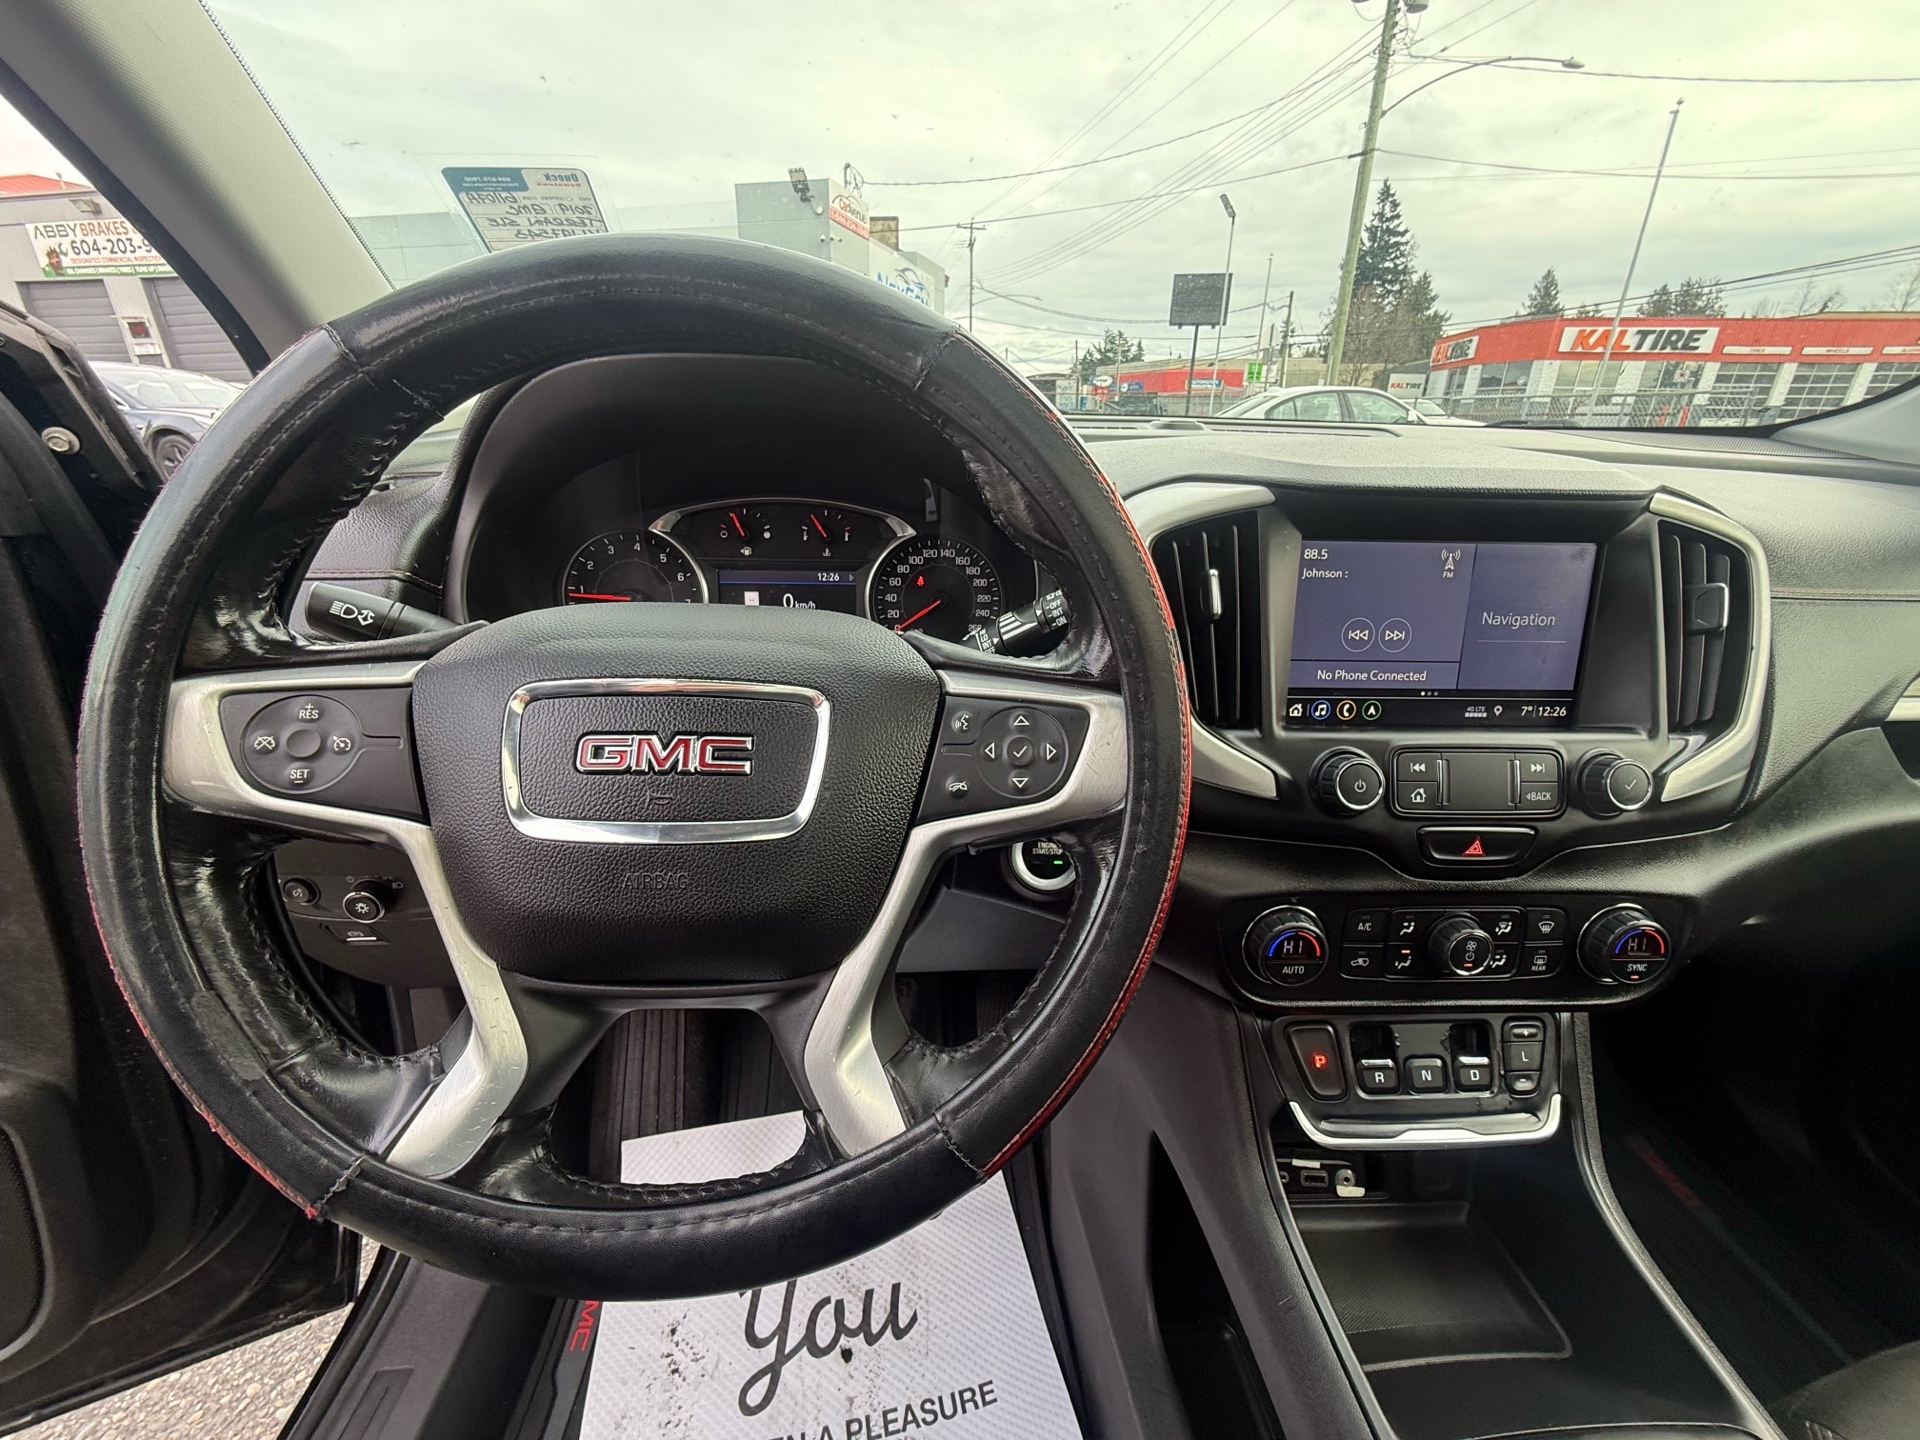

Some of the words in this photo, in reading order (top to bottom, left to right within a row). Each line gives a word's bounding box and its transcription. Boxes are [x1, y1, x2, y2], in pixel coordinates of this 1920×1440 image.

[34, 222, 77, 240] ABBY
[79, 220, 130, 237] BRAKES
[70, 238, 152, 257] 604-203-9
[1571, 329, 1631, 350] KAL
[1634, 329, 1708, 351] TIRE
[608, 546, 614, 554] 3
[634, 543, 641, 551] 4
[660, 554, 668, 562] 5
[922, 549, 938, 558] 120
[940, 549, 955, 558] 140
[1304, 548, 1328, 560] 88.5
[908, 556, 924, 564] 100
[955, 557, 970, 565] 160
[586, 562, 594, 570] 2
[897, 565, 910, 574] 80
[966, 567, 980, 575] 180
[677, 573, 684, 582] 6
[817, 572, 840, 582] 12:26
[1302, 568, 1344, 580] Johnson
[889, 578, 901, 586] 60
[782, 593, 794, 608] 0
[794, 601, 816, 610] km/h
[885, 594, 897, 602] 40
[1049, 600, 1062, 610] OFF
[887, 610, 900, 618] 20
[1052, 606, 1063, 618] INT
[1056, 616, 1067, 626] ON
[1482, 611, 1556, 629] Navigation
[982, 639, 992, 650] INT
[1316, 670, 1332, 681] No
[1334, 670, 1368, 682] Phone
[1370, 670, 1427, 682] Connected
[298, 709, 319, 720] RES
[1520, 706, 1533, 716] 7°
[1538, 706, 1567, 718] 12:26
[576, 734, 753, 775] GMC
[290, 769, 310, 780] SET
[1530, 791, 1552, 802] BACK
[622, 872, 689, 890] AIRBAG
[1358, 921, 1372, 932] A/C
[1282, 965, 1305, 974] AUTO
[1626, 963, 1648, 972] SYNC
[1312, 1054, 1328, 1068] P
[1522, 1050, 1529, 1062] L
[1374, 1072, 1384, 1084] R
[1422, 1070, 1432, 1082] N
[1470, 1070, 1480, 1081] D
[570, 1300, 600, 1352] MC
[738, 1278, 918, 1416] You
[846, 1380, 998, 1440] PLEASURE
